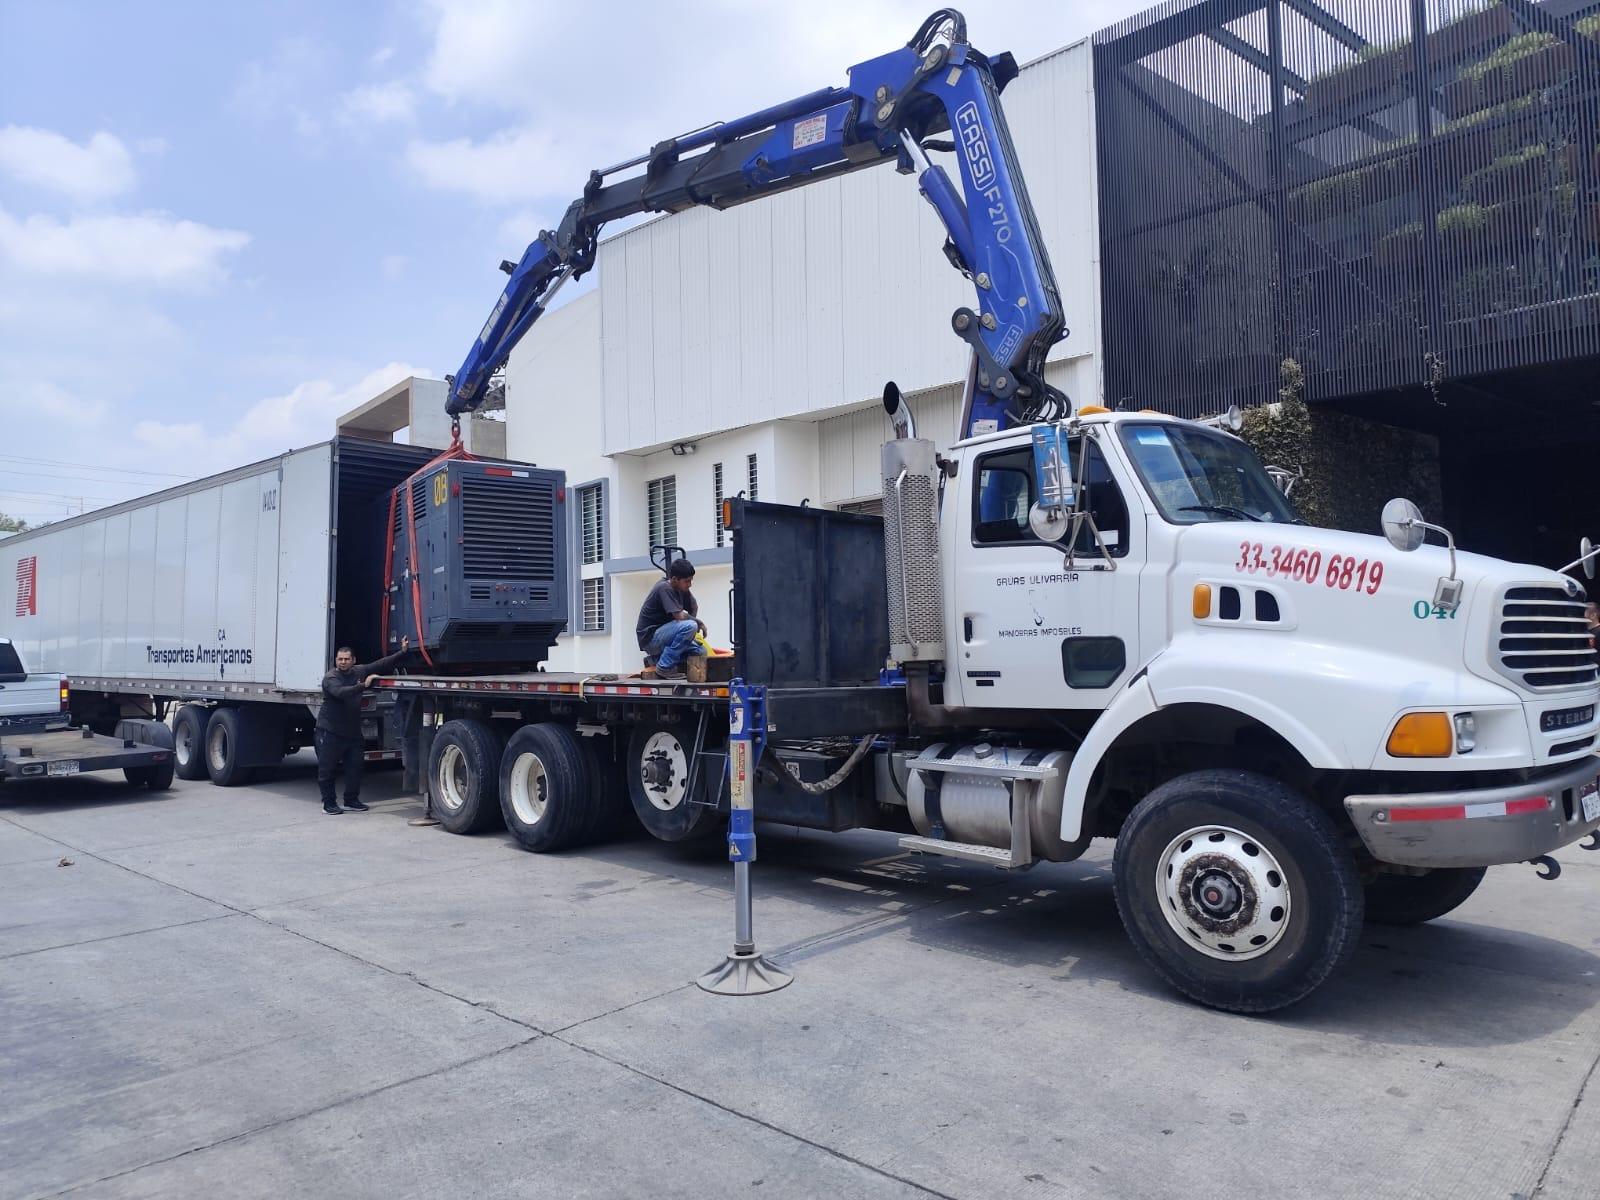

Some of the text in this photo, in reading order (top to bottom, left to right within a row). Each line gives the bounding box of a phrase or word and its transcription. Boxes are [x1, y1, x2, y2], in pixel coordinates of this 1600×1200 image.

[959, 108, 1011, 243] FASSI F270
[995, 329, 1019, 365] FASS
[1236, 541, 1384, 595] 33-3460 6819
[146, 644, 252, 668] Transportes Americanos
